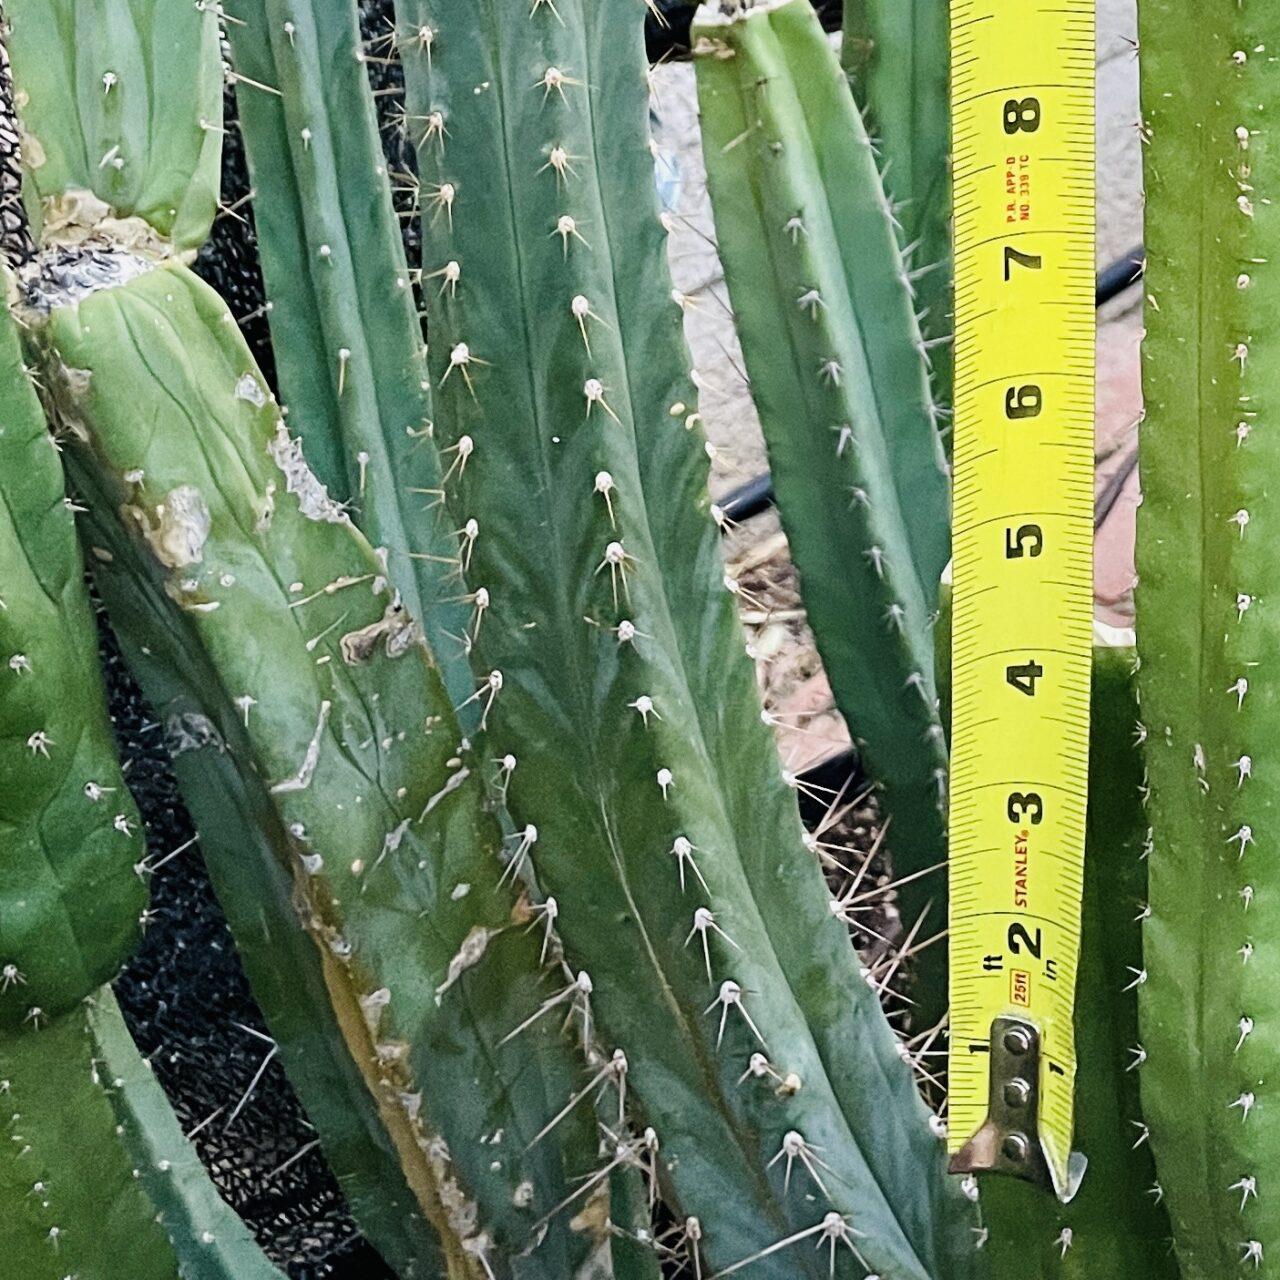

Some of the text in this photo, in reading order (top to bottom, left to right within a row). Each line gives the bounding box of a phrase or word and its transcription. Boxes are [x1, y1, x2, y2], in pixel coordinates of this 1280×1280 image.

[1003, 97, 1040, 134] 8
[1020, 155, 1029, 170] TC
[1005, 246, 1042, 281] 7
[1006, 384, 1042, 419] 6
[1006, 524, 1042, 558] 5
[1006, 659, 1042, 697] 4
[1007, 792, 1043, 825] 3
[1008, 922, 1041, 960] 2
[983, 955, 1003, 971] ft
[1042, 959, 1057, 981] in
[1014, 973, 1027, 1003] 25ft
[969, 1044, 990, 1054] 1
[1049, 1062, 1064, 1076] 1
